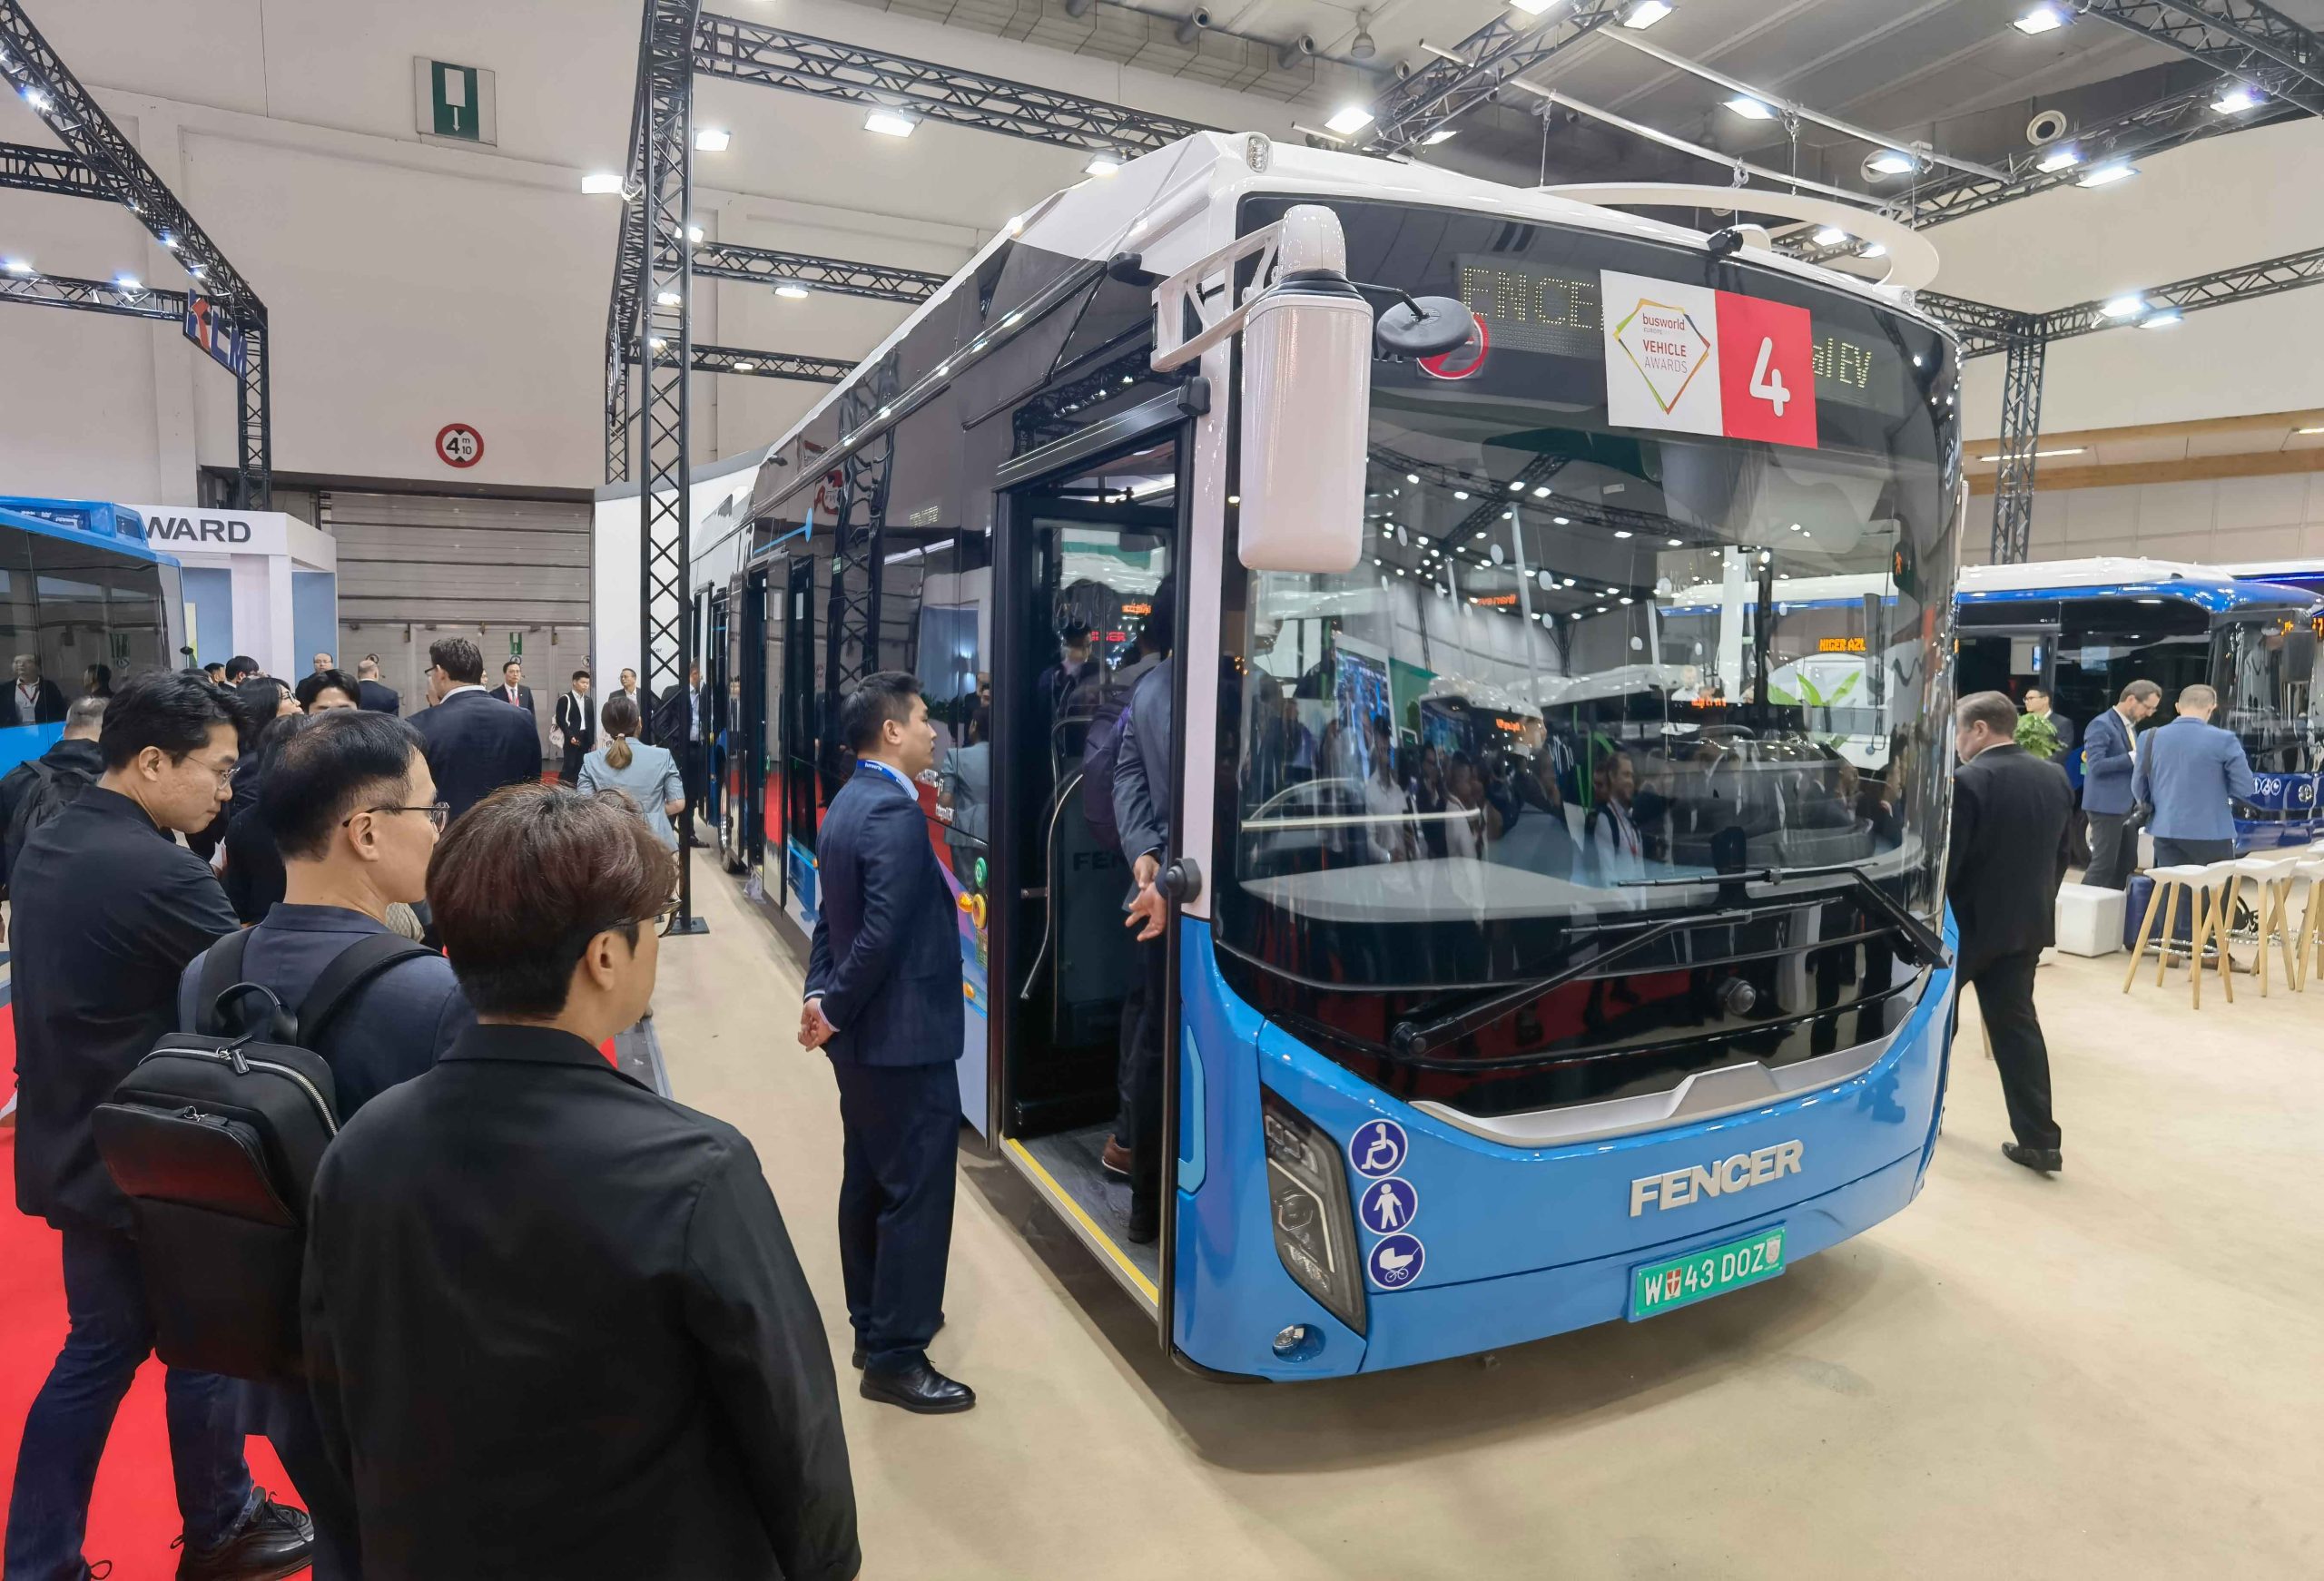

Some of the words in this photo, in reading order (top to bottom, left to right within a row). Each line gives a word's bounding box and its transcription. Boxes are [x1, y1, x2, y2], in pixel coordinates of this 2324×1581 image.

[1642, 313, 1686, 330] busworld
[1642, 339, 1688, 358] VEHICLE
[1644, 357, 1688, 373] AWARDS
[1839, 342, 1872, 388] EV
[1749, 337, 1790, 417] 4
[446, 437, 460, 454] 4
[462, 447, 472, 455] 10
[1630, 1139, 1804, 1217] FENCER
[1645, 1272, 1663, 1307] W
[1684, 1258, 1715, 1292] 43
